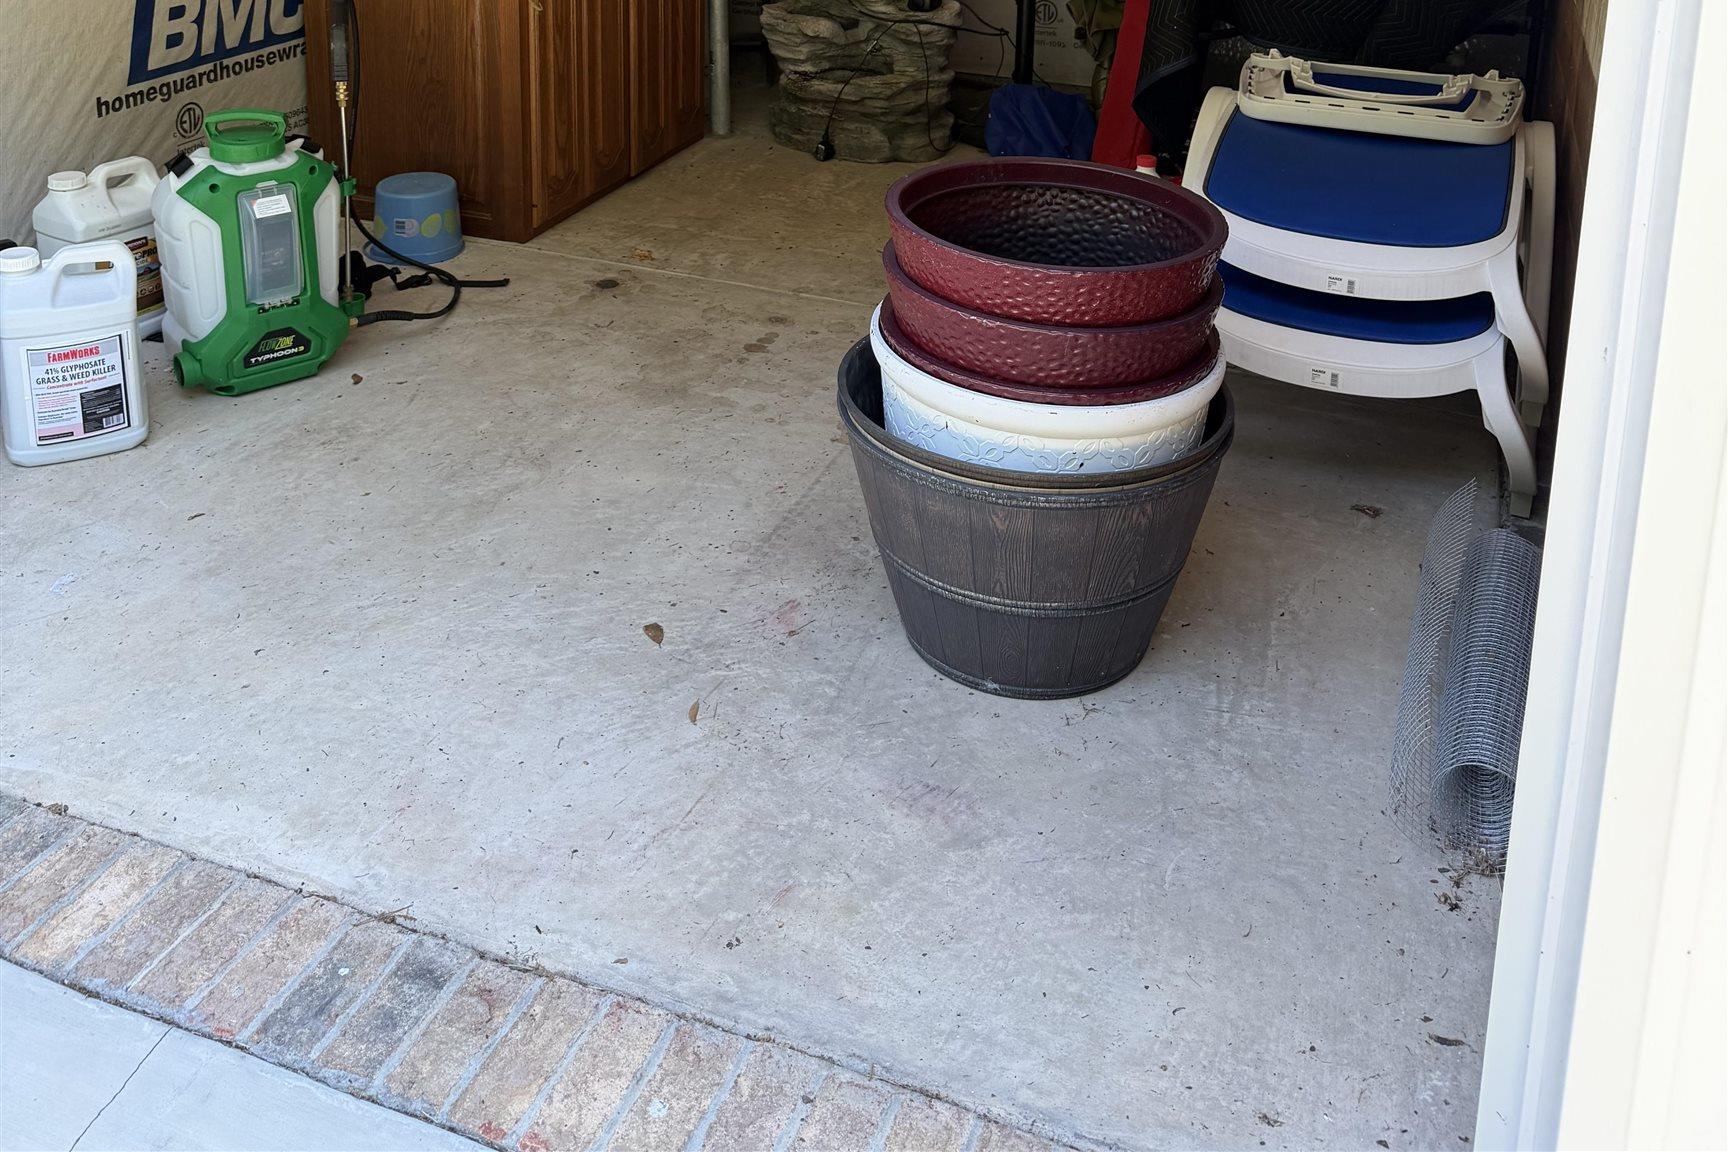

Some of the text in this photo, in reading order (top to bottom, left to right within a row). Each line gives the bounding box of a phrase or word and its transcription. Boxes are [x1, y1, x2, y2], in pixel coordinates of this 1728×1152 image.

[35, 364, 116, 385] GRASS & WEED KILLER
[44, 358, 106, 376] 41% GLYPHOSATE
